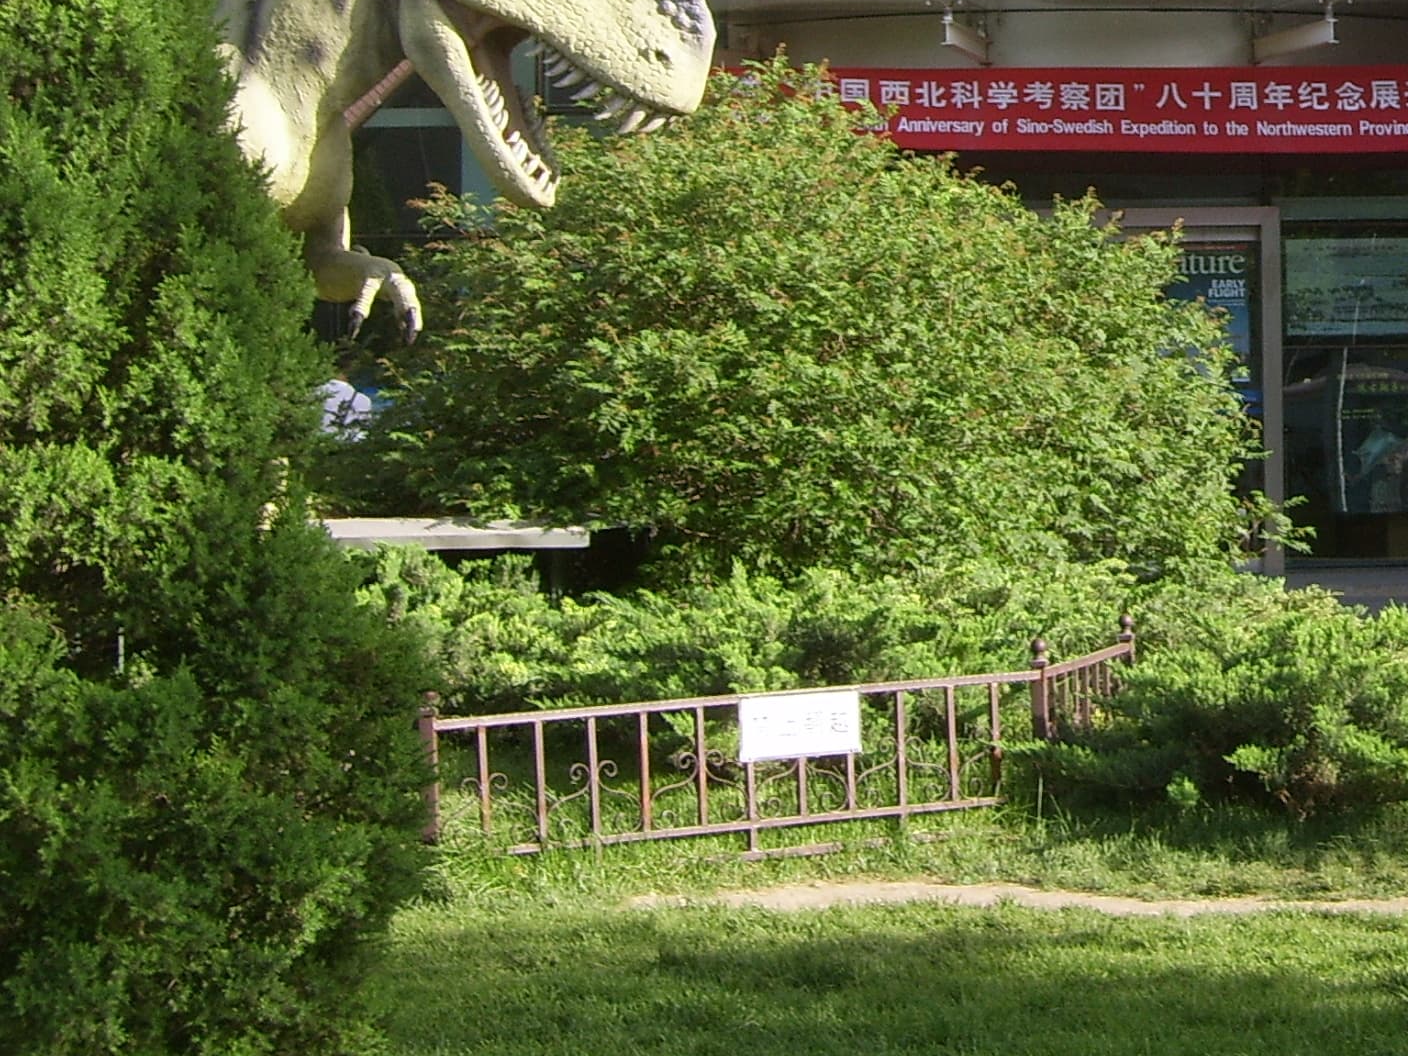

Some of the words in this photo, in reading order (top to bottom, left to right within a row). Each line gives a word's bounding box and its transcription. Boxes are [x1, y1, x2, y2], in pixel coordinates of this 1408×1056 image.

[898, 116, 984, 136] Anniversary
[992, 117, 1008, 133] of
[1016, 116, 1113, 135] Sino-Swedish
[1120, 118, 1196, 138] Expedition
[1203, 120, 1218, 136] to
[1226, 120, 1249, 136] the
[1256, 119, 1352, 137] Northwestern
[1178, 253, 1246, 275] ture
[1211, 279, 1246, 289] EARLY
[1207, 288, 1246, 298] FLIGHT
